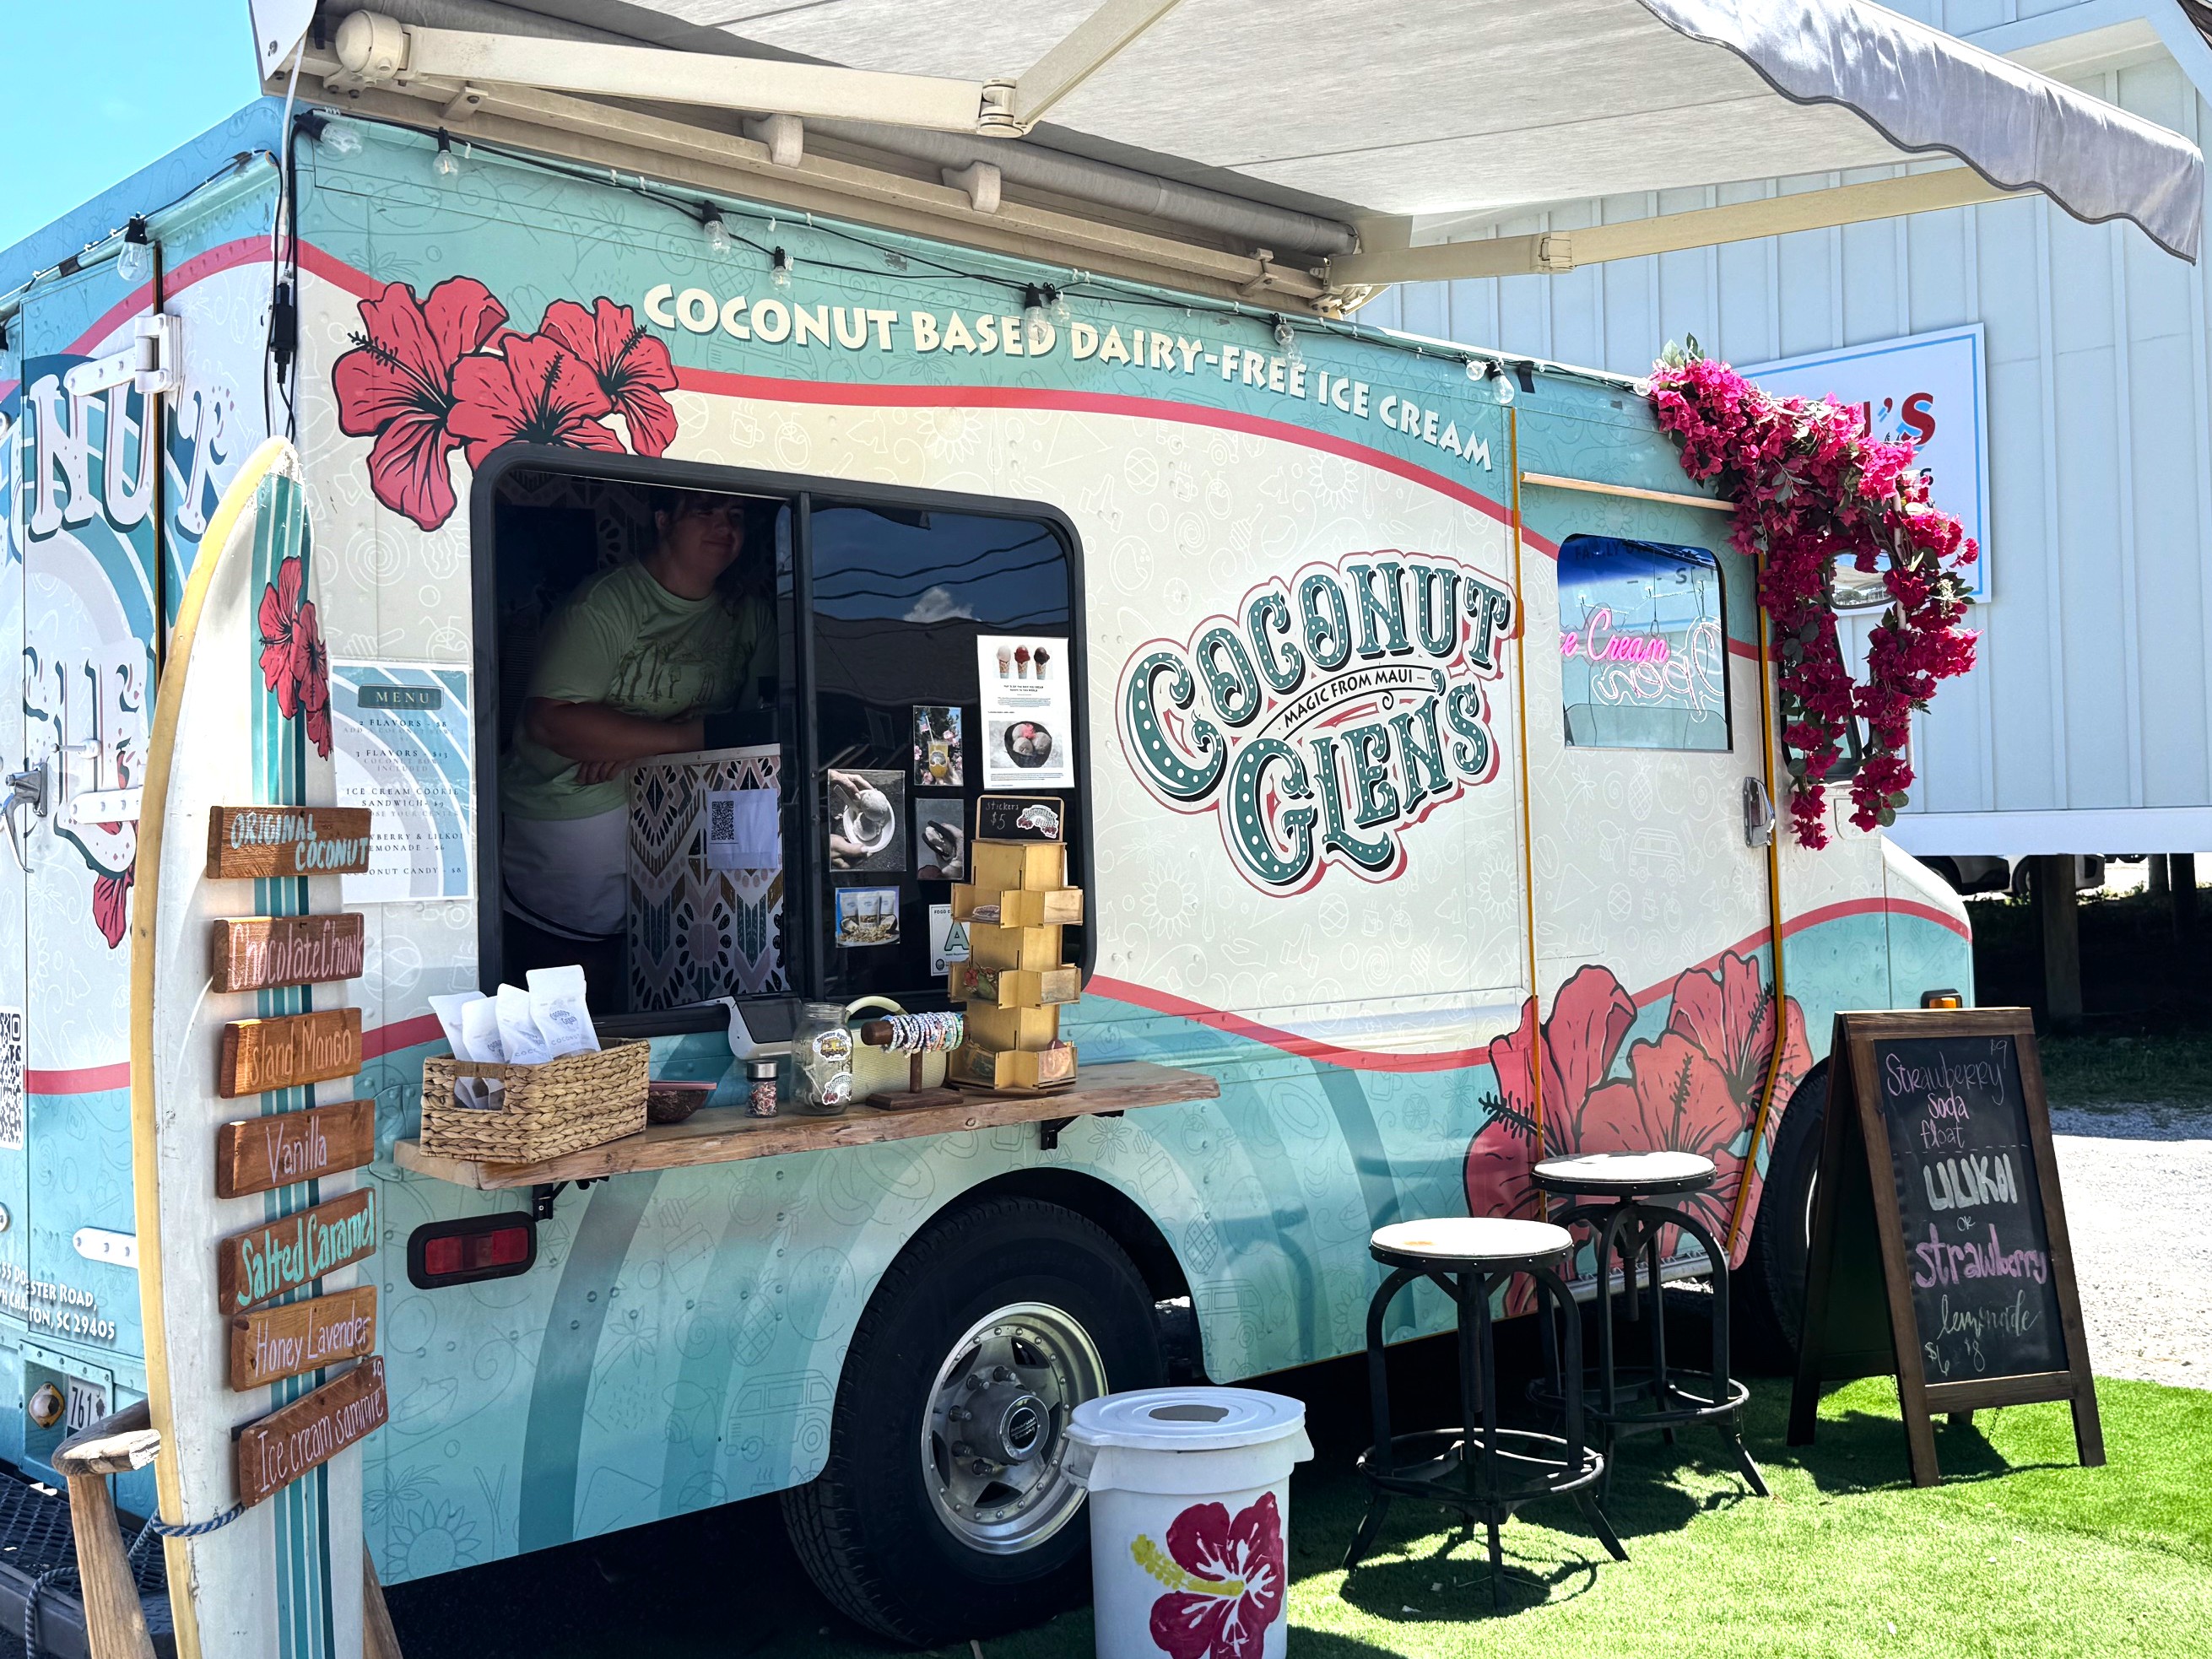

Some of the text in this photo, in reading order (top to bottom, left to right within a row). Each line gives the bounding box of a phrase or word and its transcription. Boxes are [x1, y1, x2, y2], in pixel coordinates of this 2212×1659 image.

[644, 284, 1493, 472] COCONUT BASED DAIRY-FREE ICE CREAM
[1587, 608, 1670, 662] Cream
[376, 691, 430, 704] MENU
[1127, 560, 1510, 802] COCONUT
[1284, 669, 1412, 728] MAGIC FROM MAUI
[1227, 669, 1490, 885] GLEN'S
[230, 812, 317, 850] ORIGINAL
[990, 812, 1006, 830] $5
[295, 837, 369, 871] COCONUT
[944, 921, 970, 951] A
[245, 1023, 295, 1092] Island
[265, 1115, 327, 1185] Vanilla
[1920, 1118, 1966, 1149] float
[237, 1191, 376, 1306] Salted Caramel
[57, 1310, 70, 1331] SC
[73, 1313, 116, 1340] 29405
[256, 1300, 371, 1378] Honey Lavender
[72, 1386, 92, 1429] 761
[257, 1429, 288, 1494] Ice
[289, 1414, 333, 1470] cream
